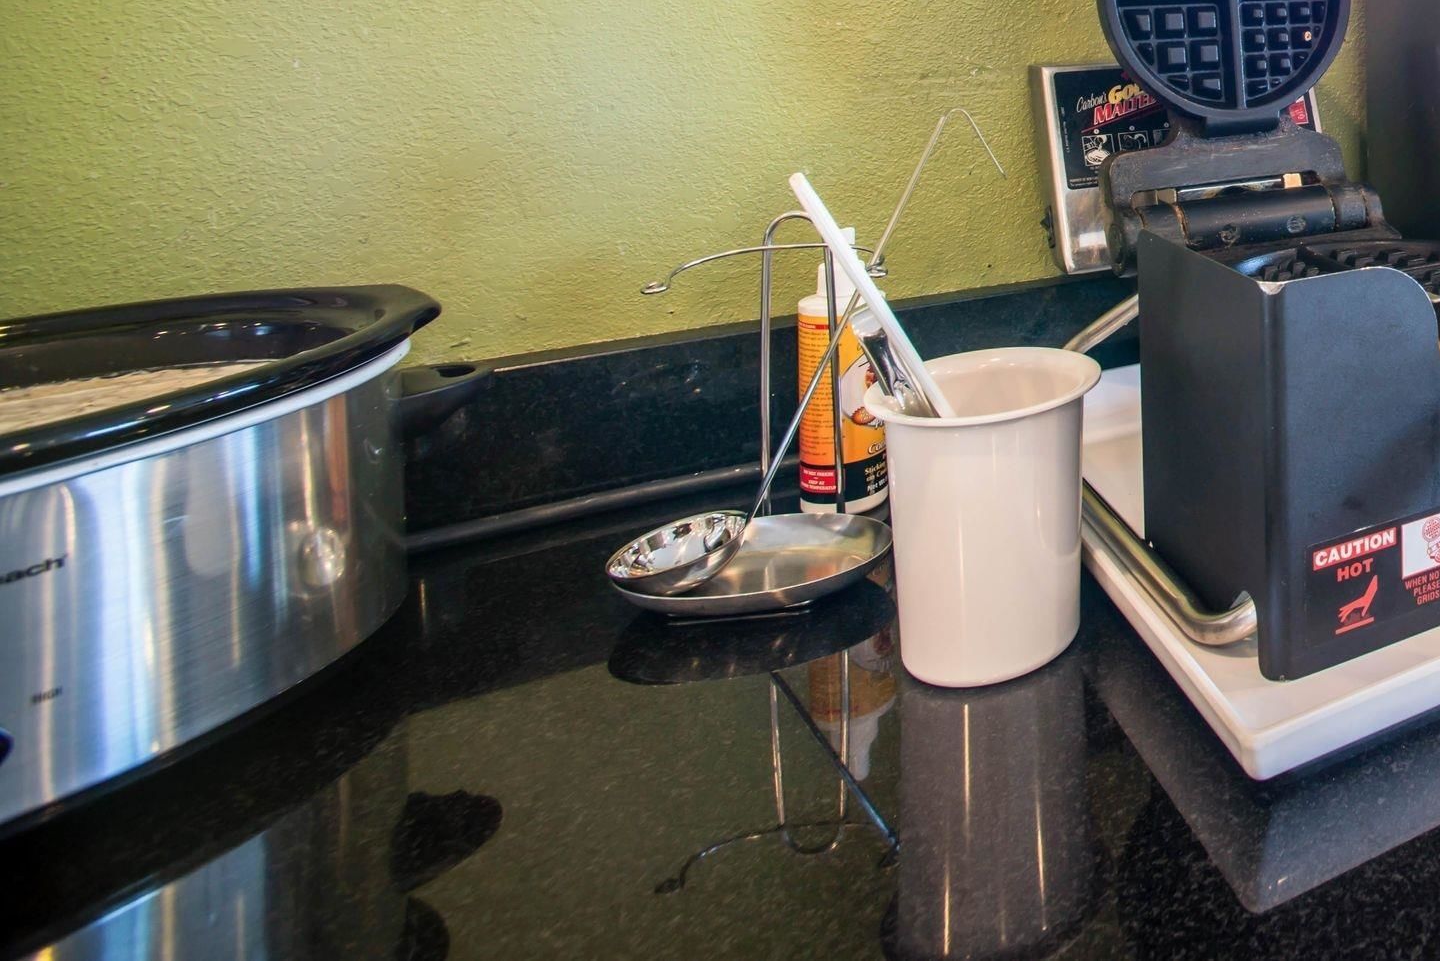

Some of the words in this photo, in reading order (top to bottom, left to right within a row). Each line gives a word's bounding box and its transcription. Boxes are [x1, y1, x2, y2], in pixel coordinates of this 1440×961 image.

[1076, 92, 1108, 114] Carbon's
[1108, 83, 1146, 105] GOL
[1314, 529, 1395, 567] CAUTION
[1336, 558, 1374, 582] HOT
[1404, 574, 1428, 590] WHEN
[1413, 580, 1440, 597] PLEASE
[1416, 590, 1440, 605] GRIDS
